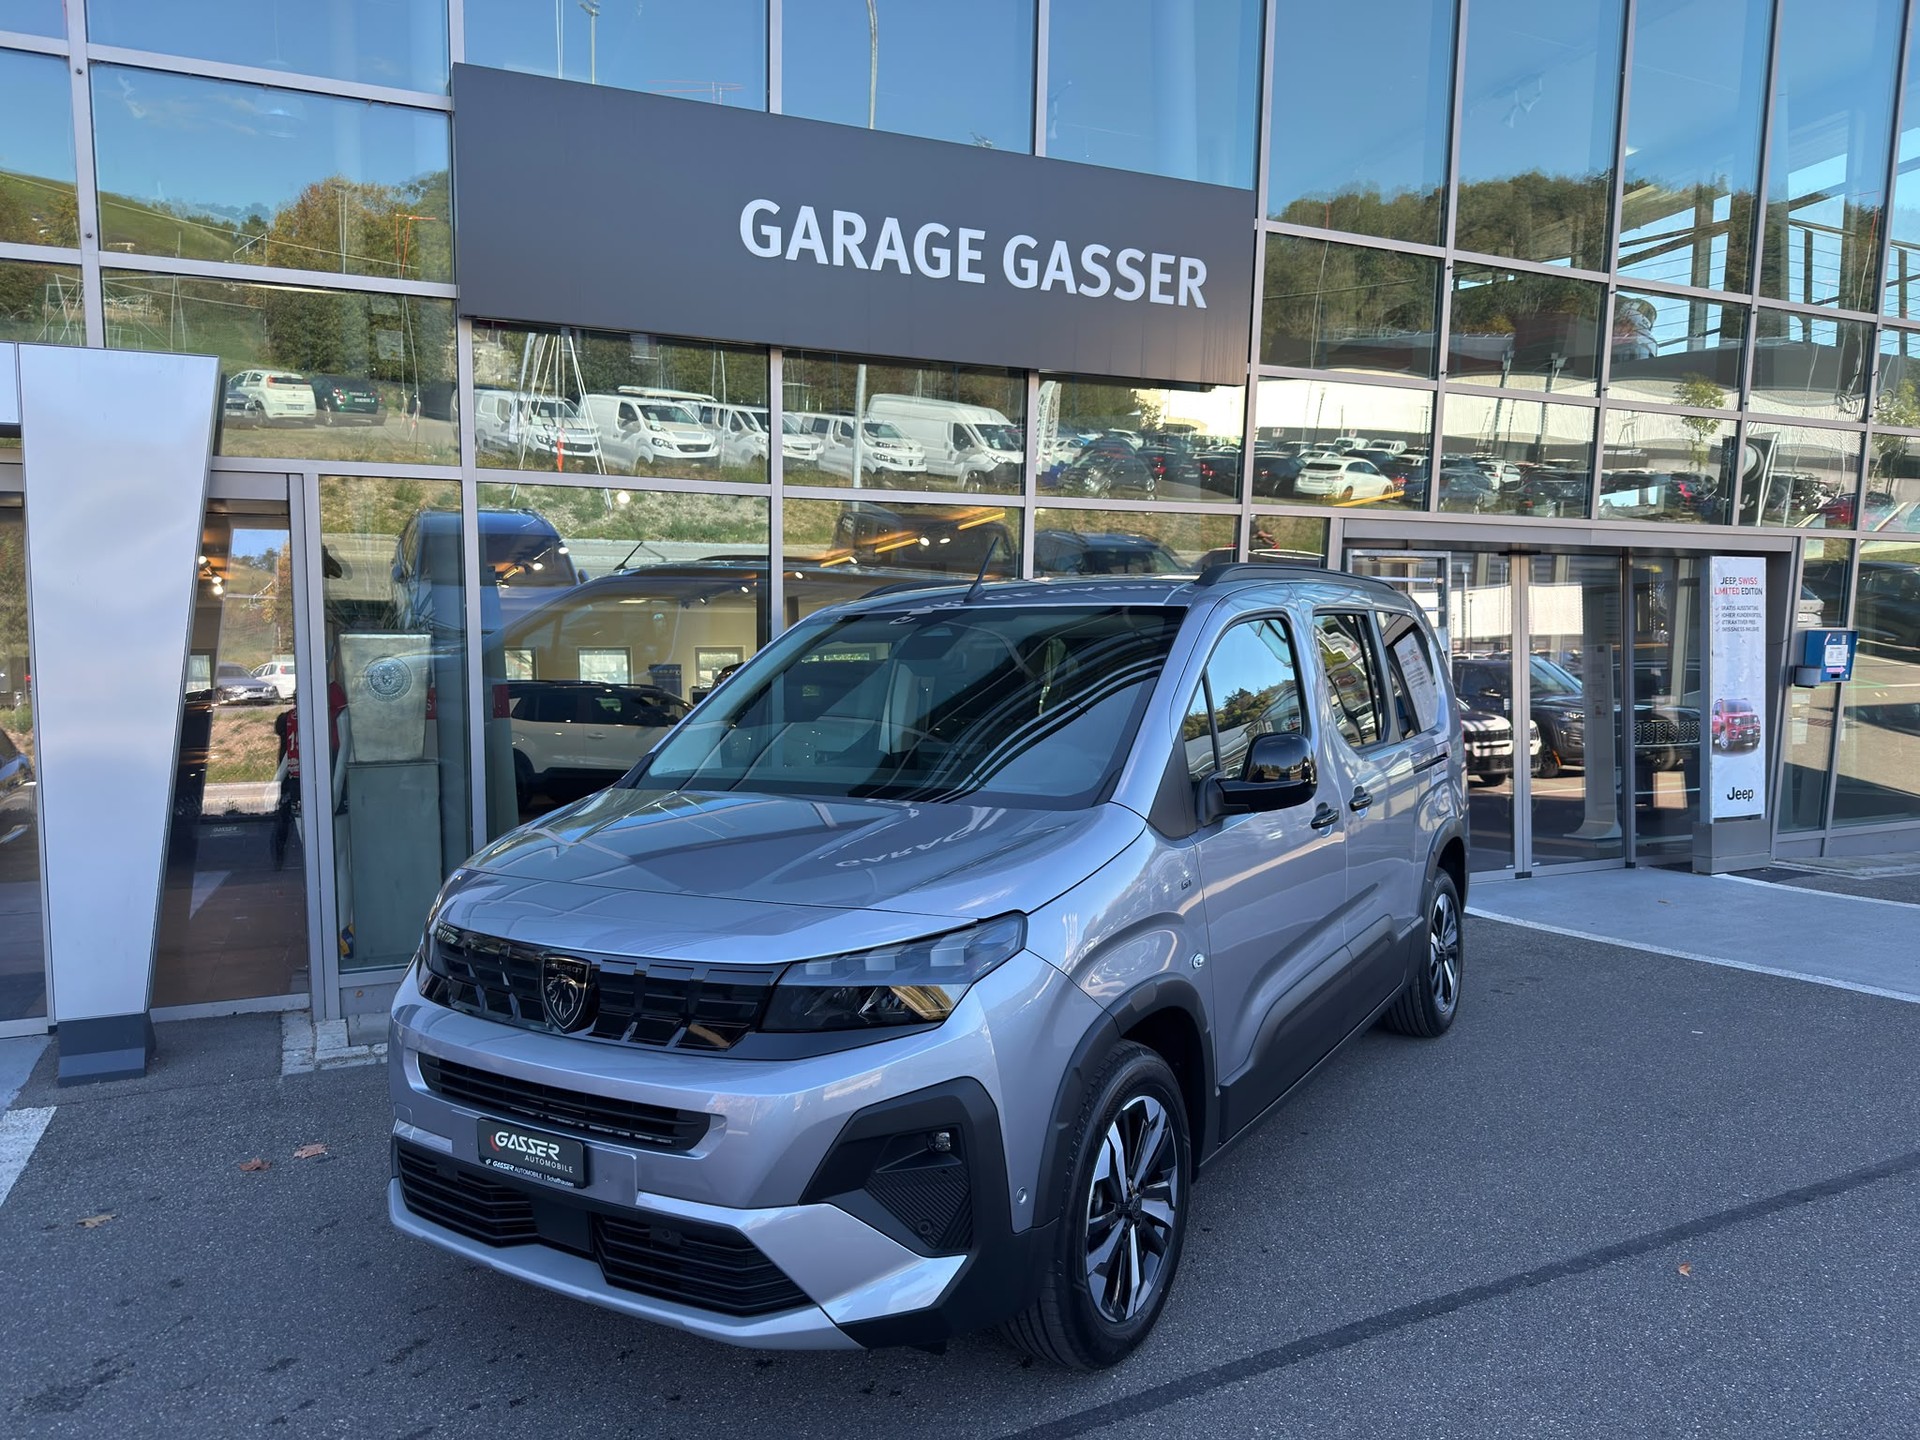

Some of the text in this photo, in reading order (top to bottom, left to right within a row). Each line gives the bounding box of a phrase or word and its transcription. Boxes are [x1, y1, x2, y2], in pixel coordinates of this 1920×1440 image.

[739, 199, 1208, 309] GARAGE GASSER
[1738, 576, 1758, 585] SWISS
[1714, 587, 1763, 595] LIMITED EDITION
[1727, 787, 1753, 801] Jeep
[495, 1131, 559, 1161] GASSER
[492, 1160, 514, 1171] GASSER
[514, 1167, 542, 1180] AUTOMOBILE
[524, 1155, 573, 1174] AUTOMOBILE
